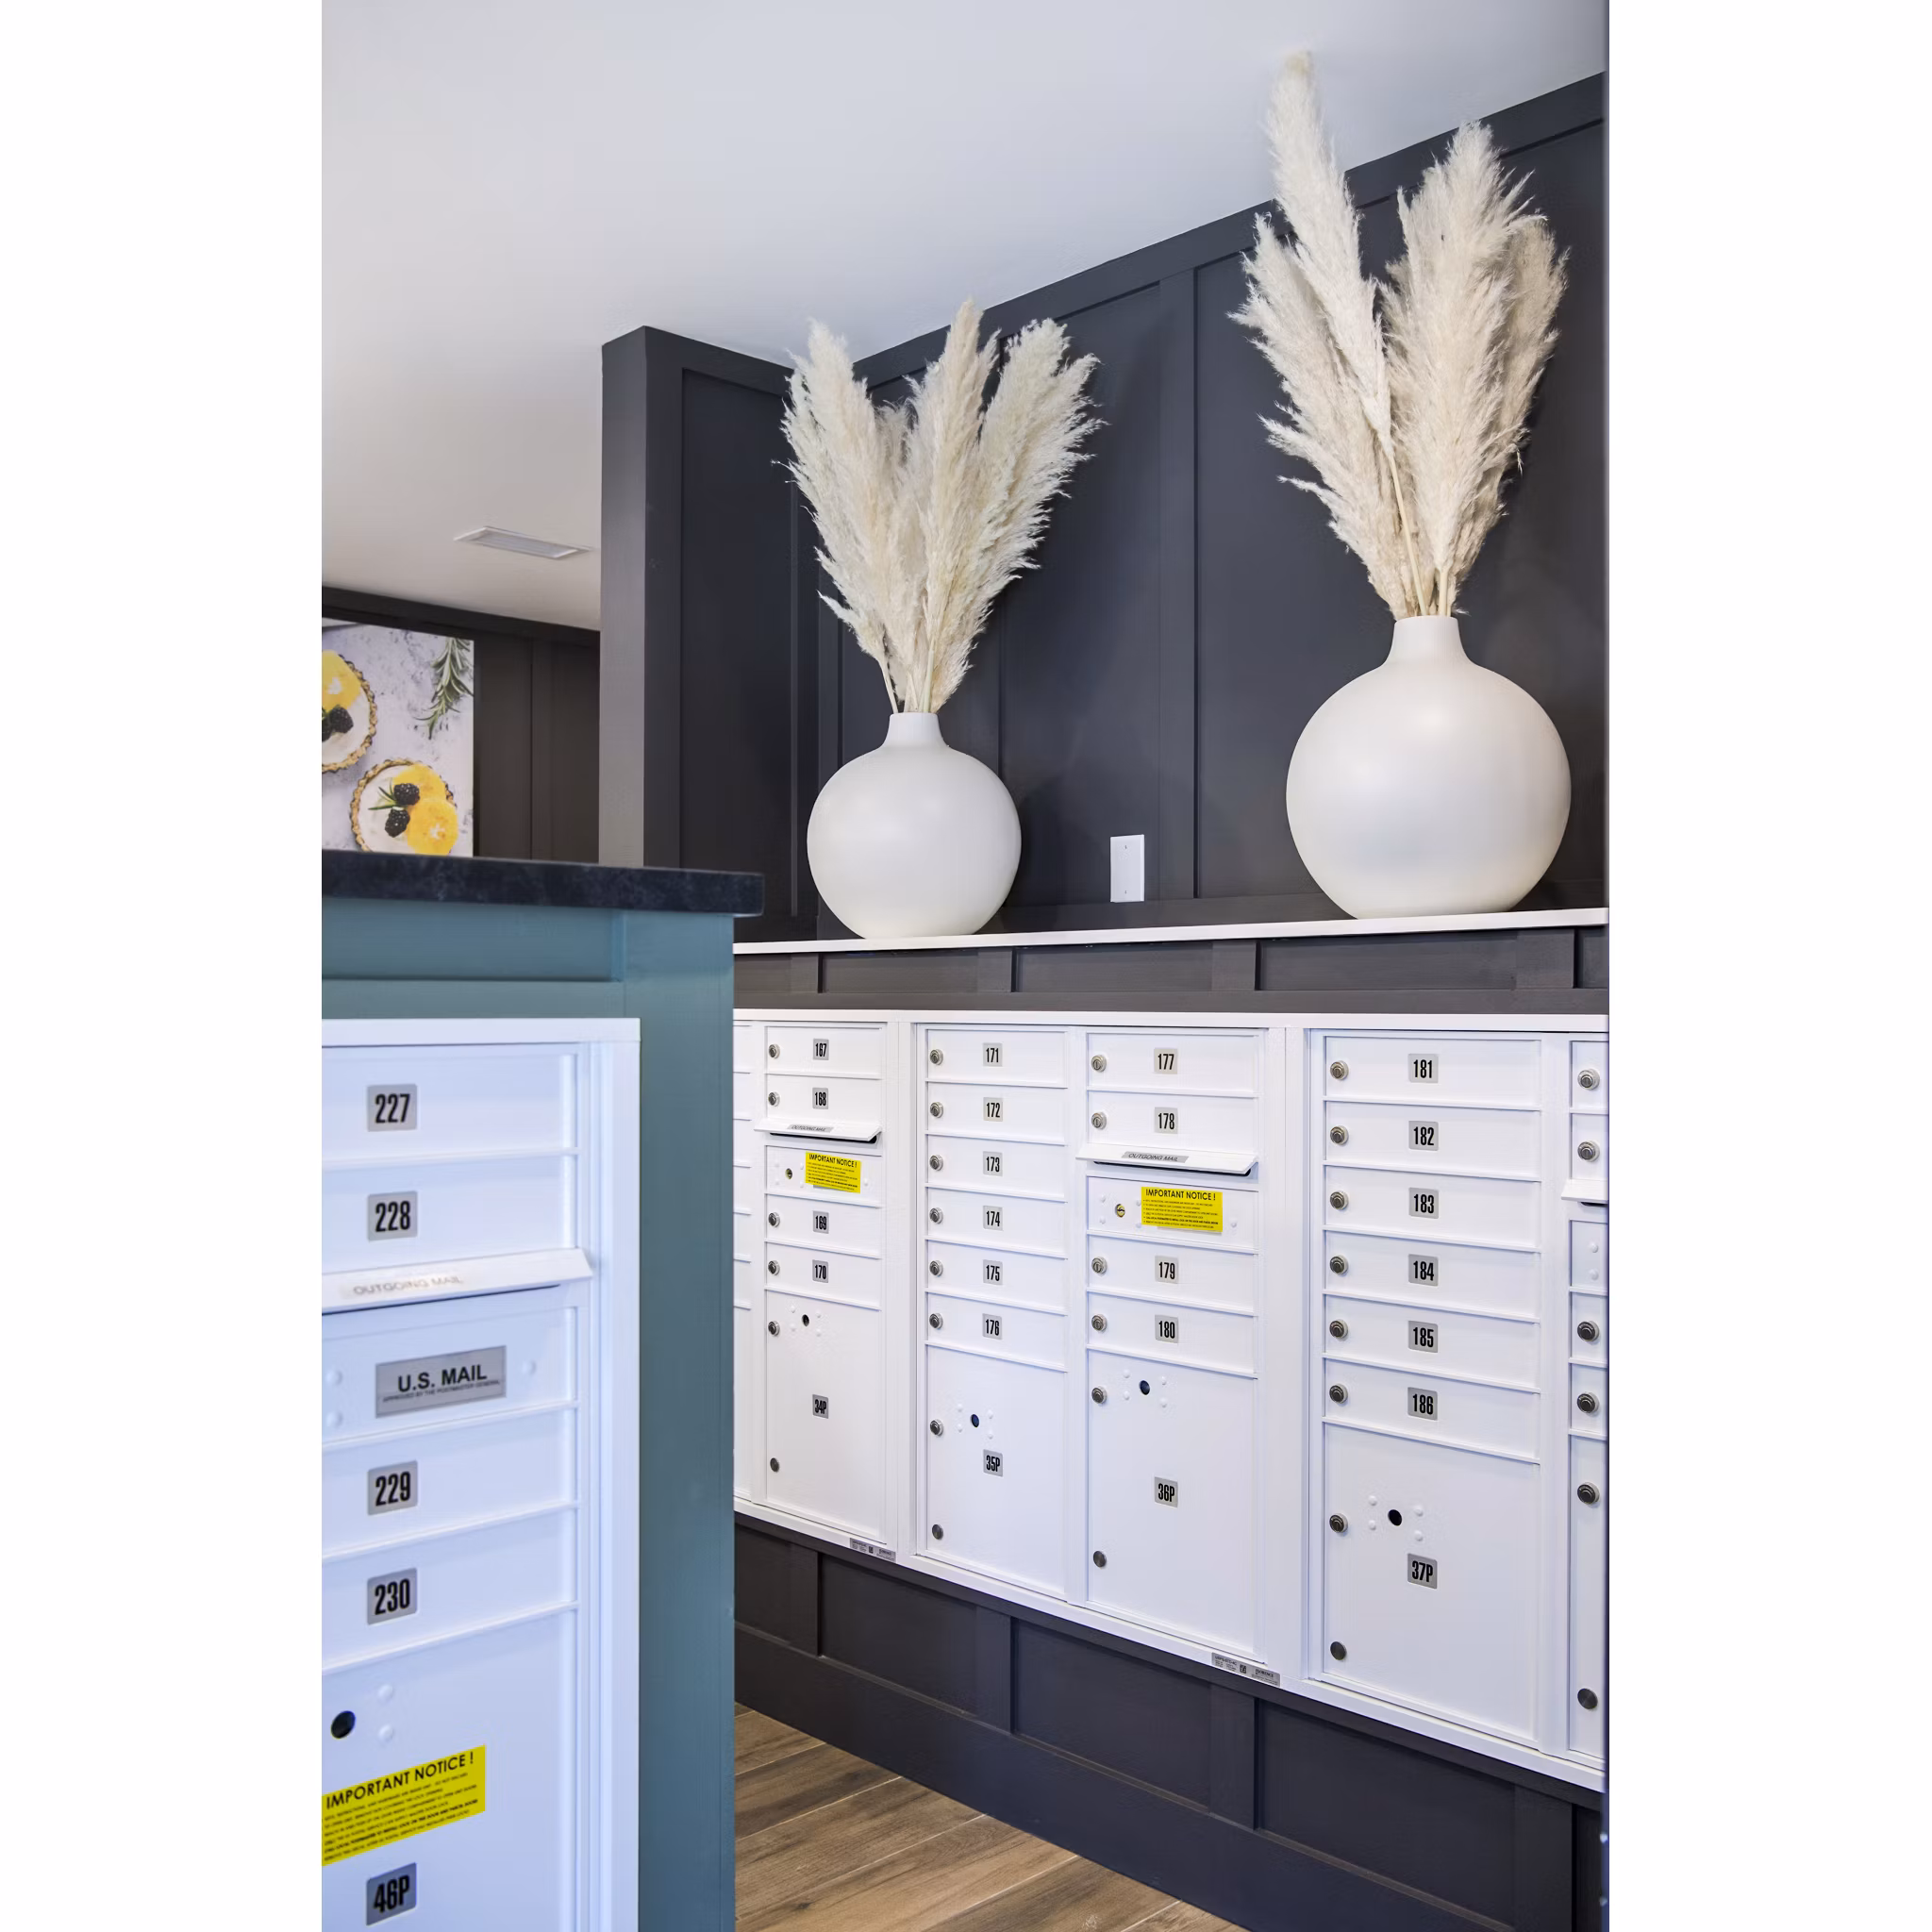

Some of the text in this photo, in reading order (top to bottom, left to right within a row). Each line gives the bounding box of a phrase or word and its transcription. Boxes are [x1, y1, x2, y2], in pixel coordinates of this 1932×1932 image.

[816, 1043, 827, 1058] 167
[987, 1048, 999, 1063] 171
[1158, 1054, 1174, 1071] 177
[1414, 1059, 1433, 1078] 181
[815, 1092, 826, 1107] 168
[375, 1093, 410, 1124] 227
[987, 1103, 1000, 1118] 172
[1158, 1113, 1174, 1129] 178
[1414, 1126, 1434, 1146] 182
[809, 1154, 836, 1164] IMPORTANT
[837, 1158, 854, 1168] NOTICE
[987, 1157, 1000, 1173] 173
[1145, 1189, 1184, 1199] IMPORTANT
[1186, 1191, 1212, 1201] NOTICE
[1414, 1194, 1434, 1214] 183
[375, 1200, 410, 1233] 228
[816, 1216, 827, 1230] 169
[987, 1211, 1000, 1226] 174
[815, 1265, 826, 1279] 170
[987, 1265, 1000, 1281] 175
[1159, 1262, 1175, 1279] 179
[1413, 1261, 1434, 1281] 184
[353, 1279, 430, 1296] OUTGOING
[986, 1320, 1000, 1336] 176
[1159, 1321, 1175, 1339] 180
[1413, 1327, 1434, 1348] 185
[398, 1363, 488, 1393] U.S. MAIL
[815, 1399, 827, 1415] 34P
[1413, 1394, 1433, 1415] 186
[987, 1455, 1000, 1473] 35P
[375, 1472, 410, 1507] 229
[1158, 1483, 1175, 1503] 36P
[1412, 1560, 1433, 1583] 37P
[375, 1579, 410, 1616] 230
[326, 1771, 410, 1810] IMPORTANT
[414, 1754, 466, 1781] NOTICE
[374, 1875, 409, 1913] 46P
